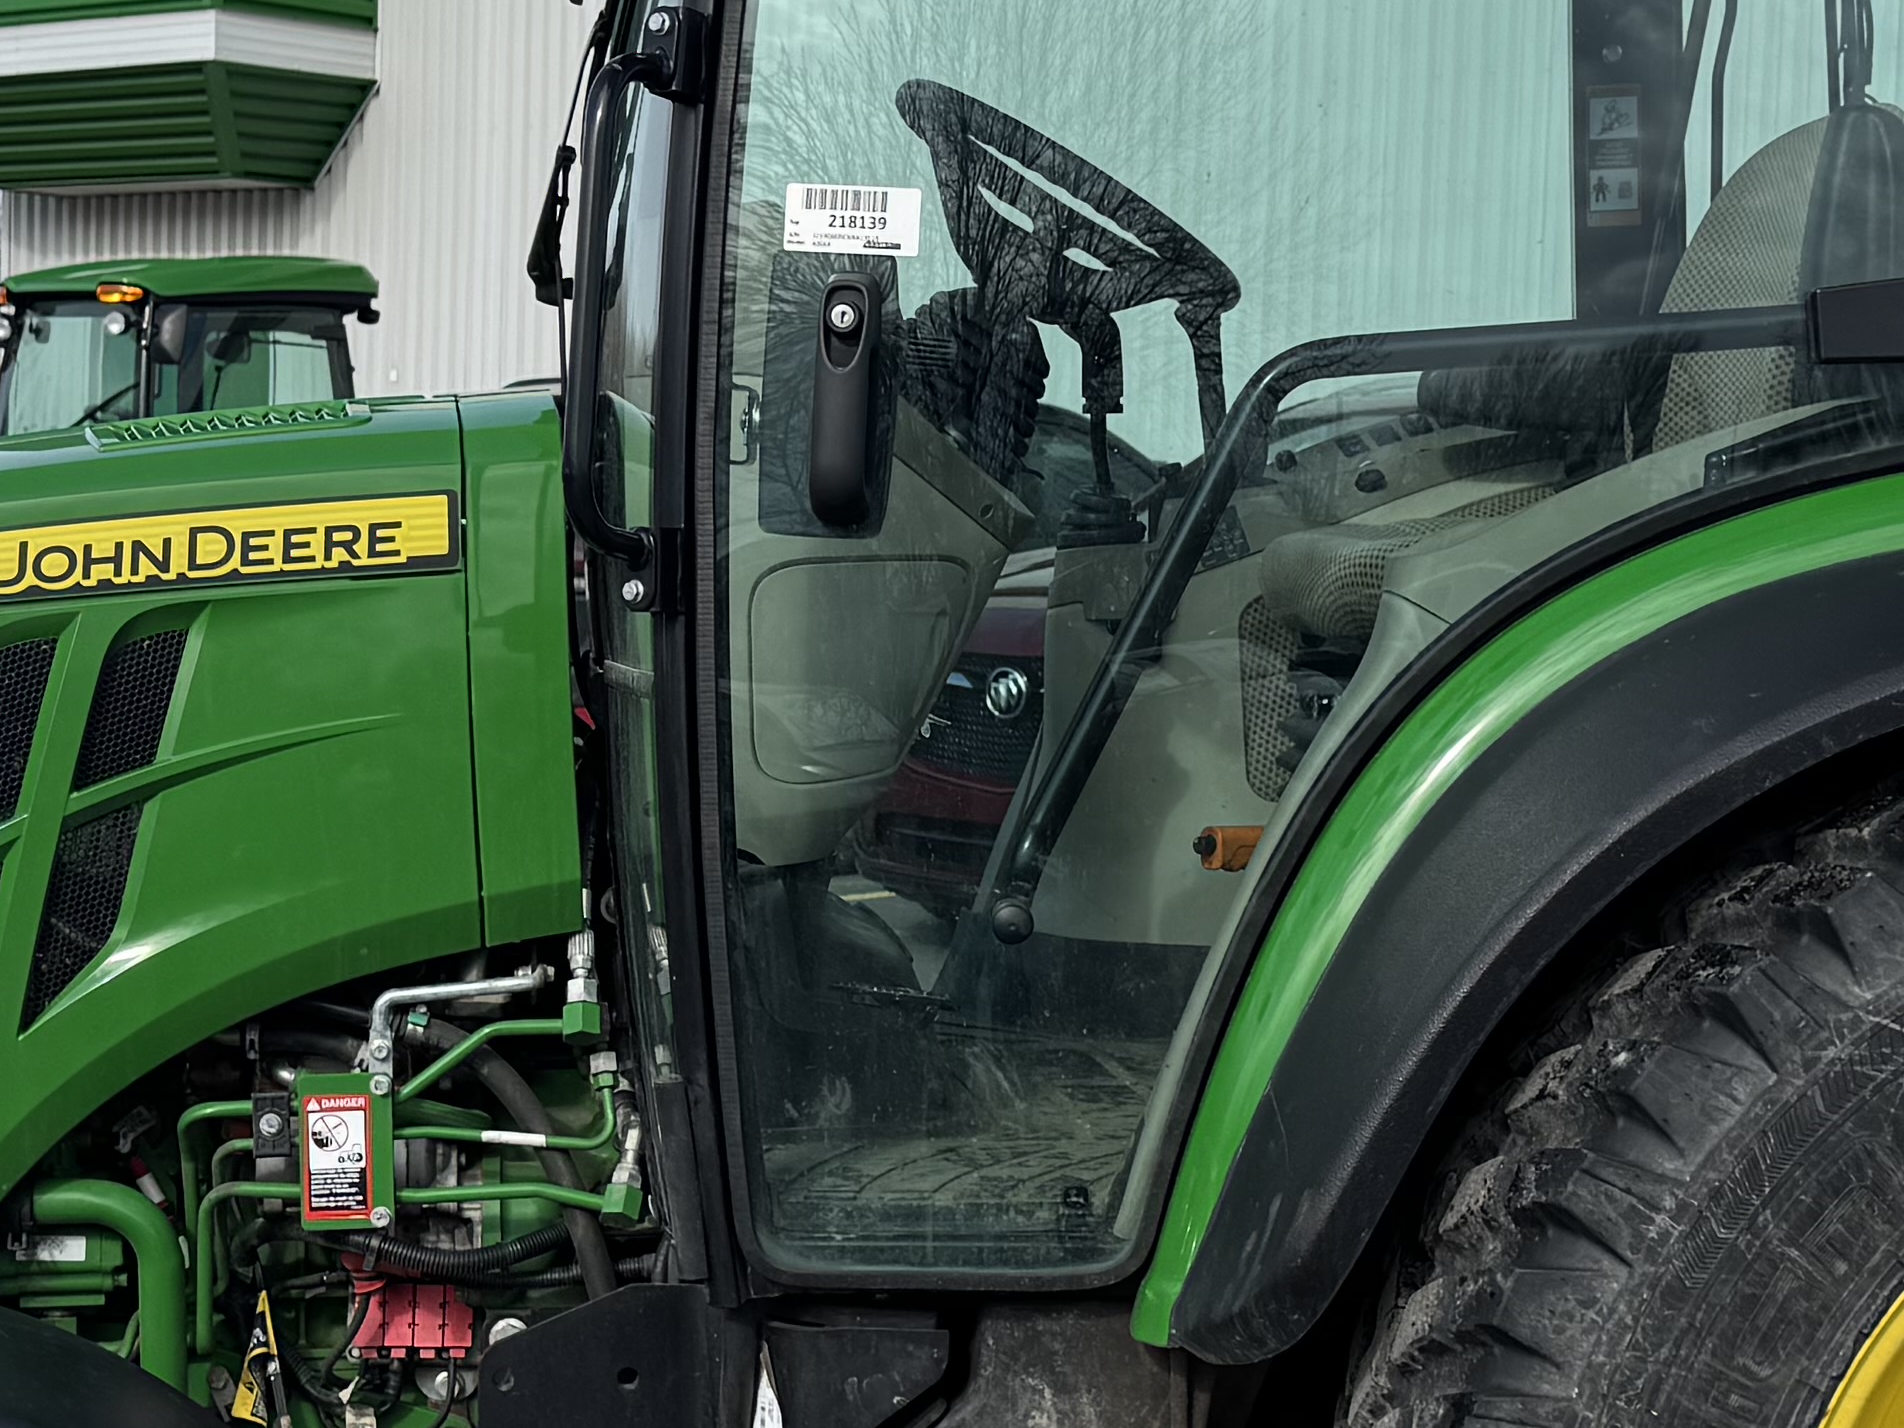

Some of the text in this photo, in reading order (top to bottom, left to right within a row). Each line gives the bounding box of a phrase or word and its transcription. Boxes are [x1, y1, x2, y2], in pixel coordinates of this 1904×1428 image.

[828, 214, 887, 230] 218139
[188, 521, 402, 571] DEERE
[321, 1097, 365, 1109] DANGER
